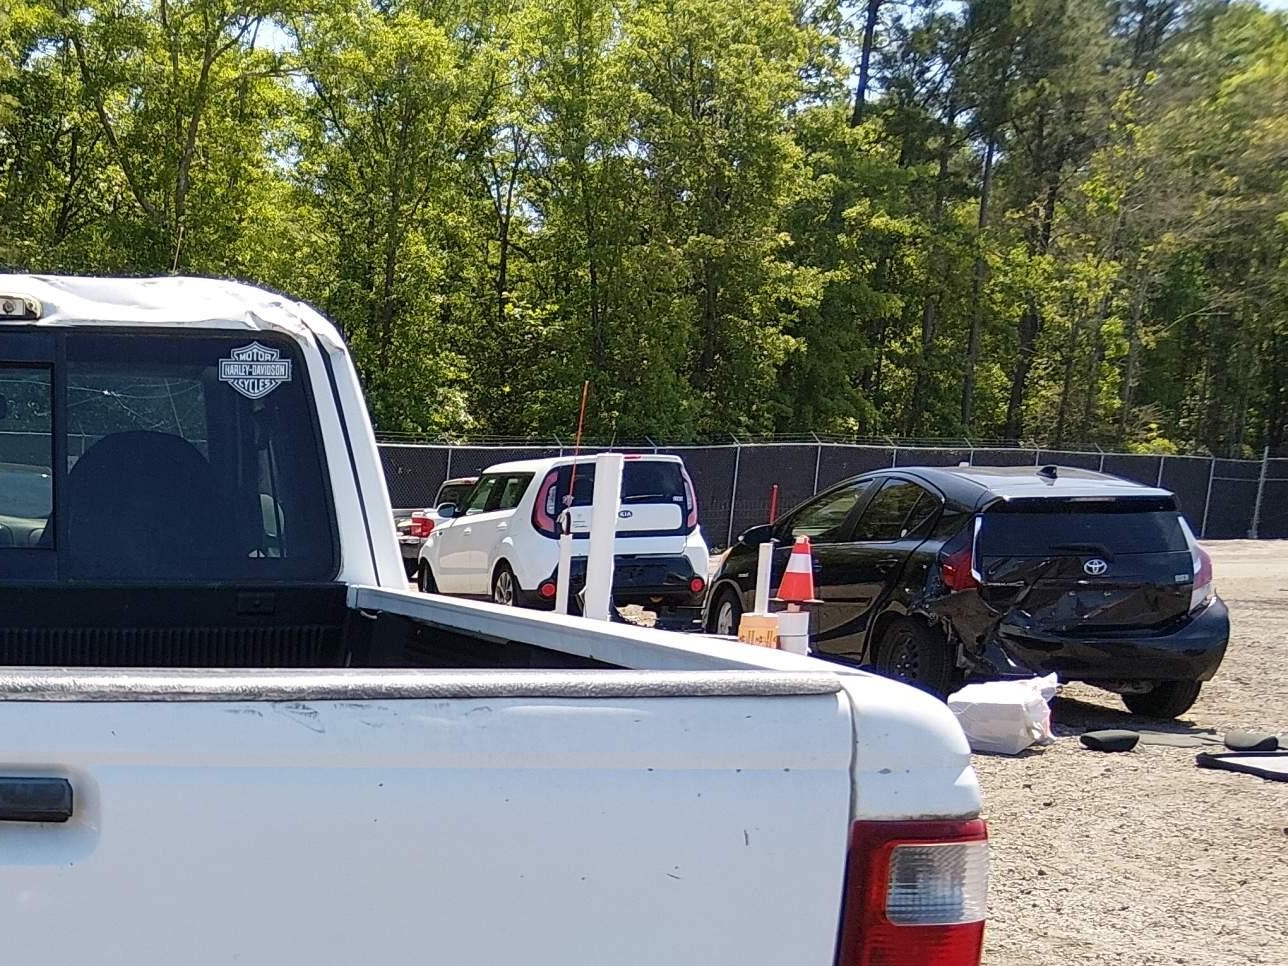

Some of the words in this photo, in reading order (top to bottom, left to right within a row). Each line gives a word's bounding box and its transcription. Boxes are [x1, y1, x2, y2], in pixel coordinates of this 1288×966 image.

[239, 349, 271, 361] MOTOR
[224, 364, 285, 376] HARLEY-DAVIDSON
[238, 379, 271, 393] CYCLES
